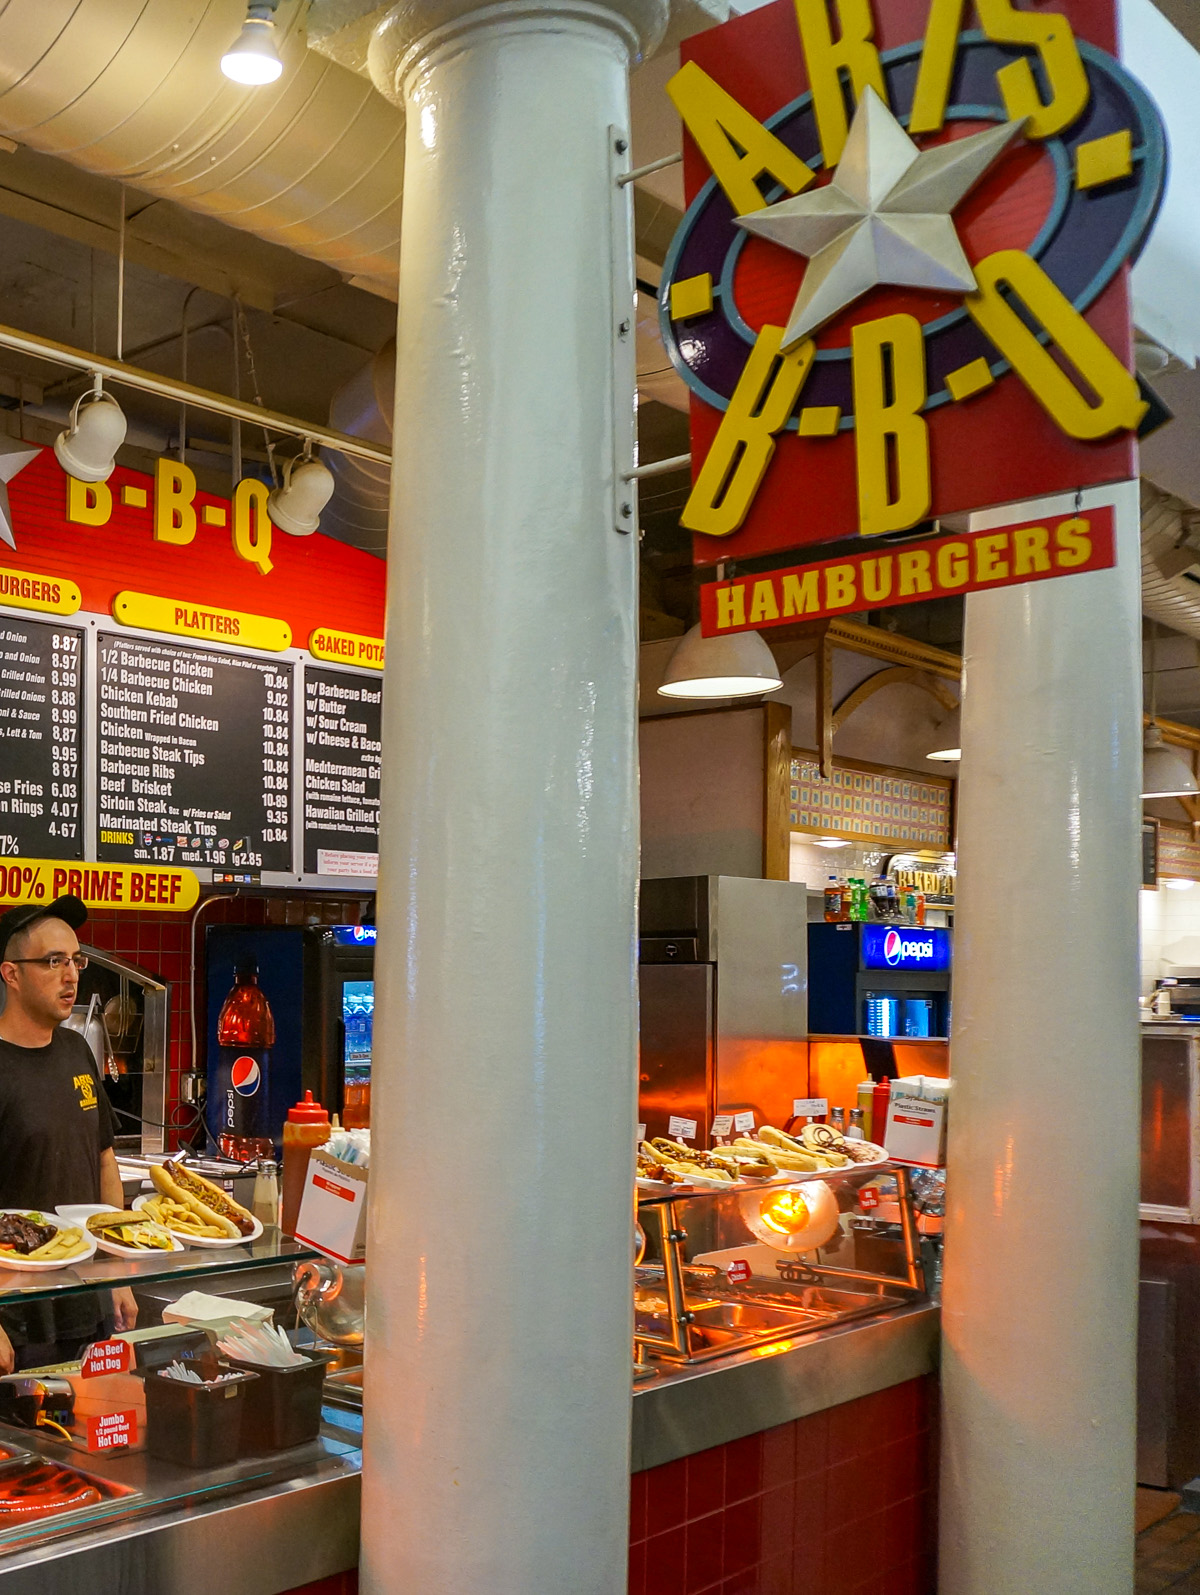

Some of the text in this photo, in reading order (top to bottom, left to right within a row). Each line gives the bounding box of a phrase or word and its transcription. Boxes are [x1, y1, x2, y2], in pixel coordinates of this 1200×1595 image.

[717, 517, 1093, 629] HAMBURGERS
[174, 607, 240, 636] PLATTERS
[318, 634, 384, 662] BAKED POTA
[100, 684, 289, 724] Chicken Kebab 10.84
[306, 697, 347, 715] w/ Butter
[51, 745, 77, 762] 9.95
[305, 774, 365, 794] Chicken Salad
[48, 821, 76, 838] 4.67
[100, 830, 134, 845] DRINKS
[133, 846, 226, 864] sm. 1.87 med. 1.96
[52, 868, 123, 903] PRIME
[130, 872, 182, 904] BEEF
[901, 938, 933, 961] pepsi
[226, 1088, 235, 1128] pepsi
[105, 1342, 124, 1356] Beef
[90, 1359, 121, 1372] Hot Dog
[99, 1414, 125, 1428] Jumbo
[97, 1433, 128, 1448] Hot Dog
